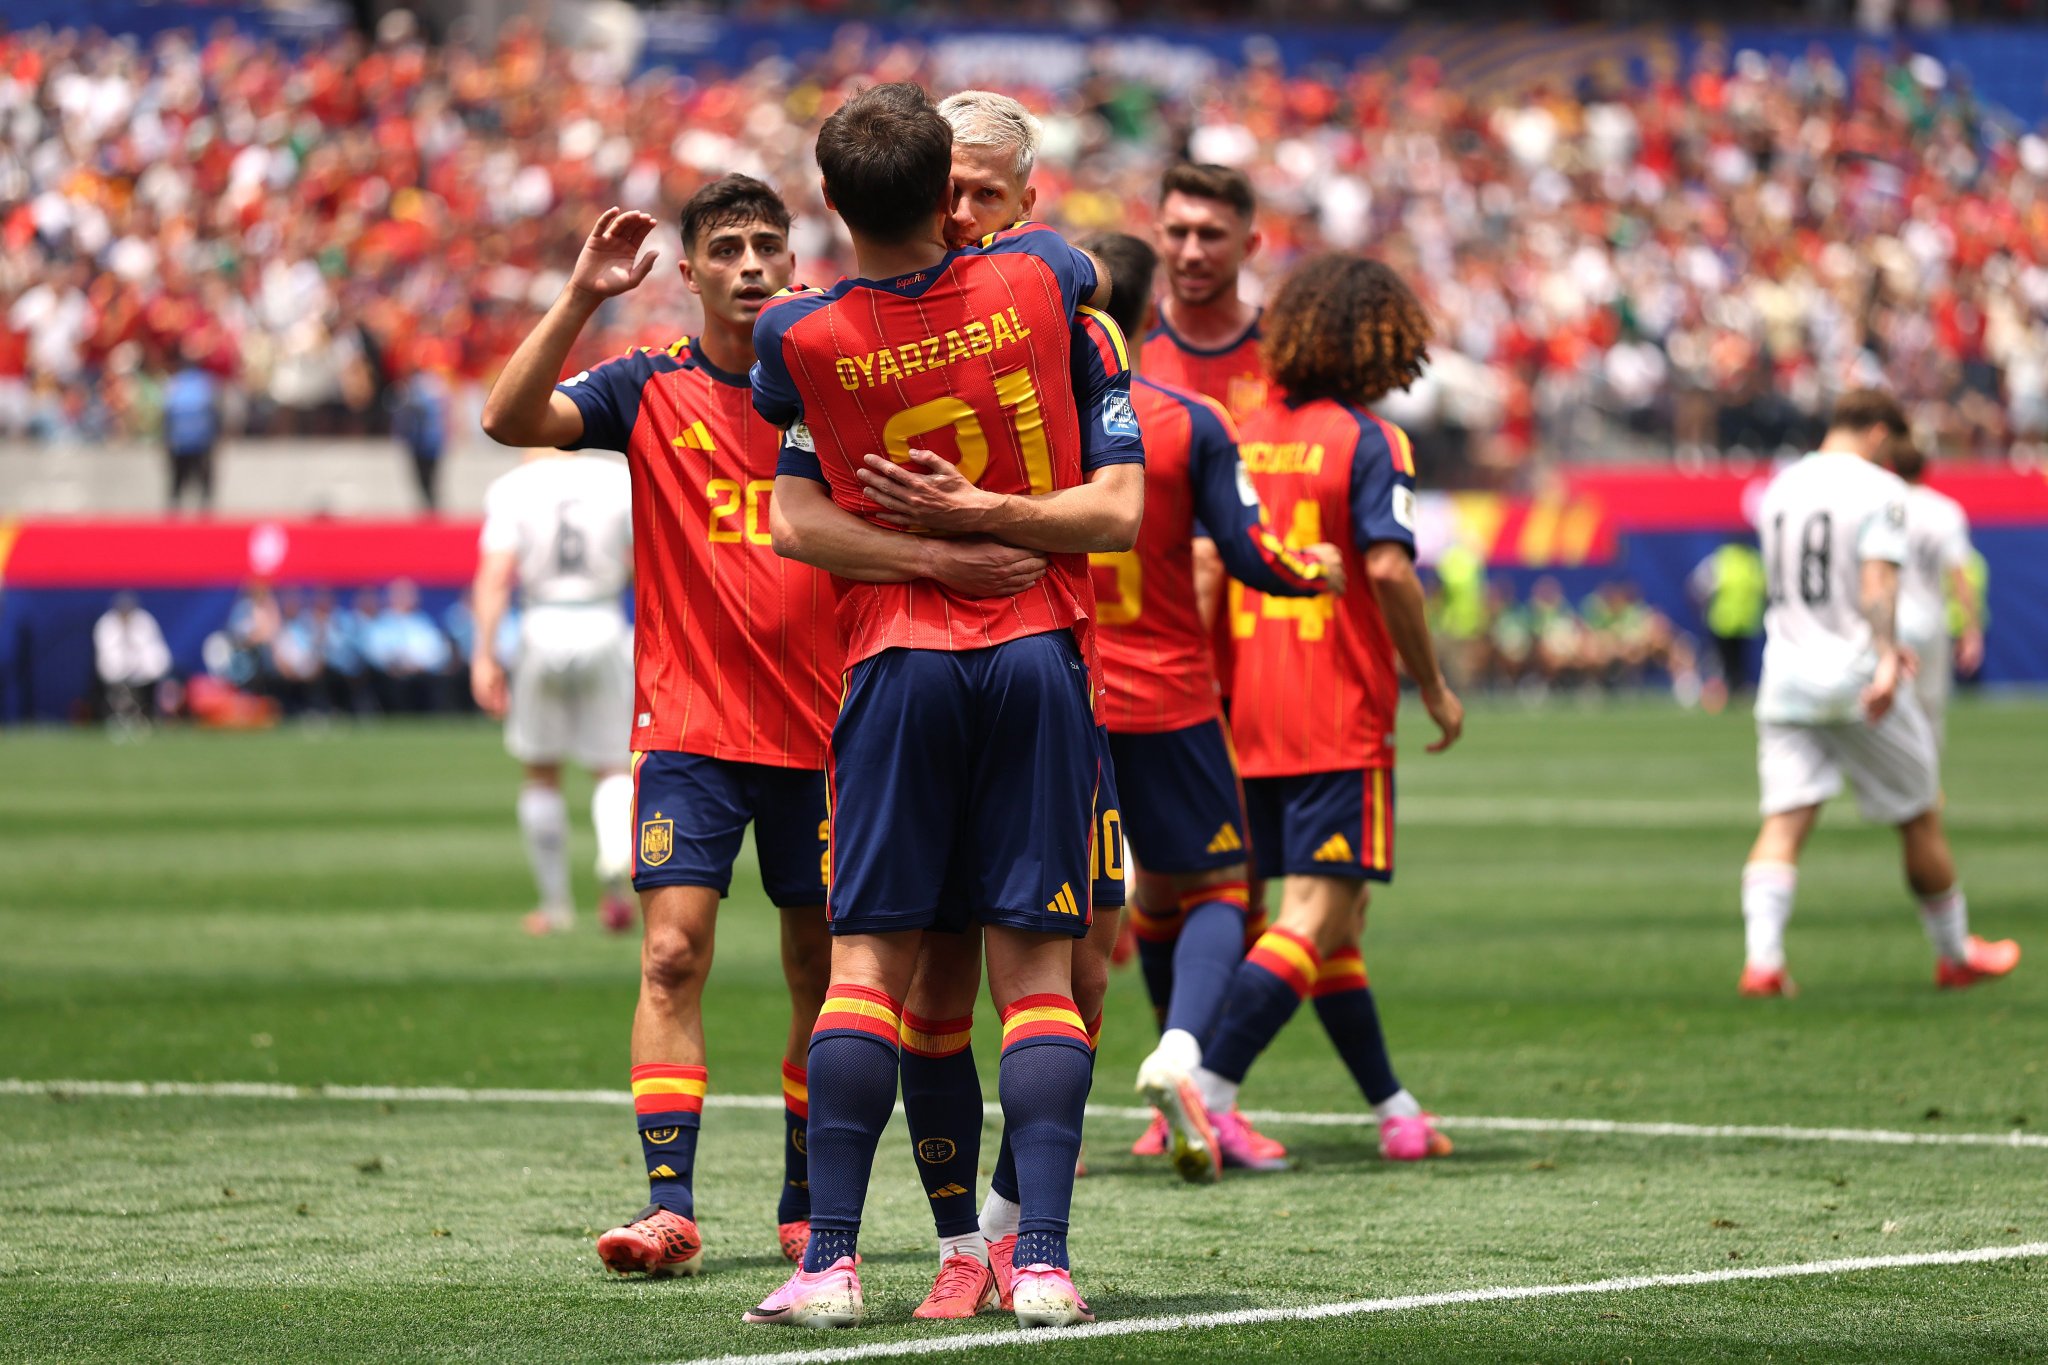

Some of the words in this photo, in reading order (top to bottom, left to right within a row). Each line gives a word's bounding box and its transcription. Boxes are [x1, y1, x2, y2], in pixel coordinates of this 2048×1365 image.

[895, 272, 928, 290] España
[834, 306, 1032, 391] OYARZABAL
[705, 478, 774, 546] 20
